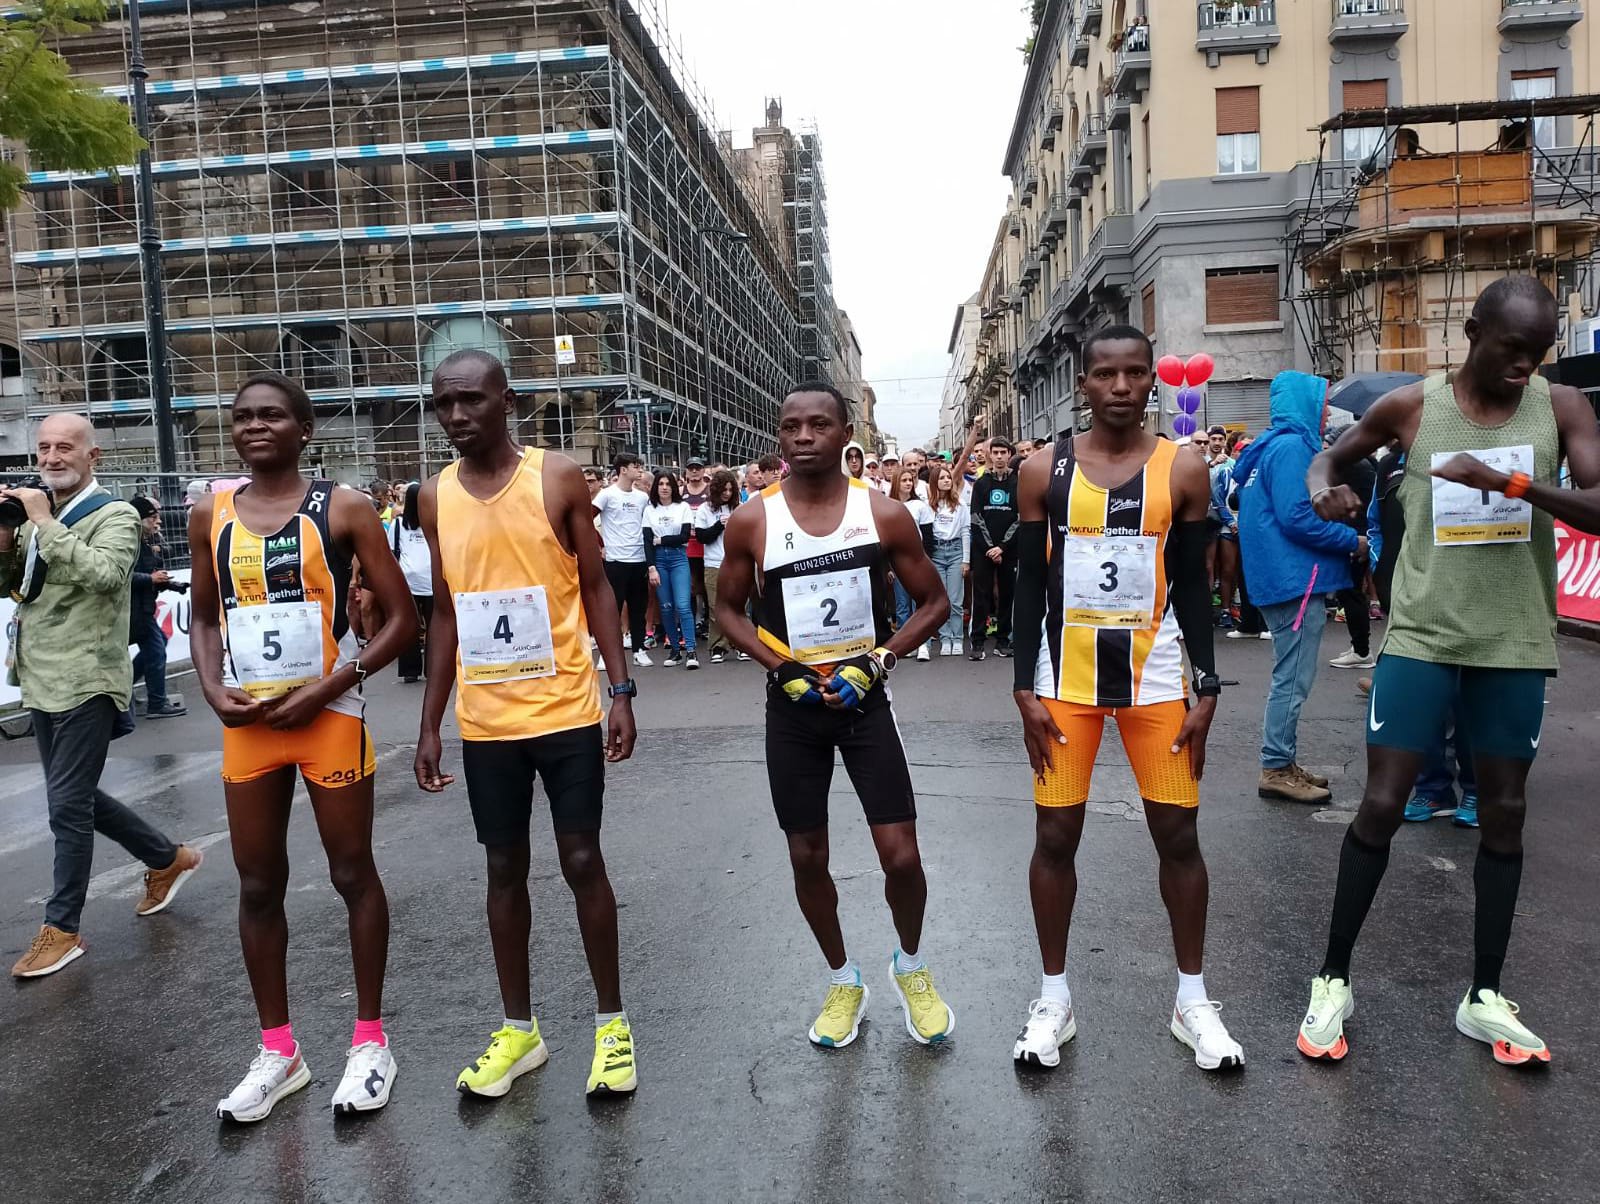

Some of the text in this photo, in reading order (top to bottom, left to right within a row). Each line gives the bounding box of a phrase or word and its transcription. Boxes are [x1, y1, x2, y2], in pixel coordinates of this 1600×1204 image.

[793, 549, 855, 573] RUN2GETHER
[1099, 561, 1119, 593] 3
[820, 598, 840, 628] 2
[493, 615, 514, 644] 4
[262, 630, 282, 661] 5
